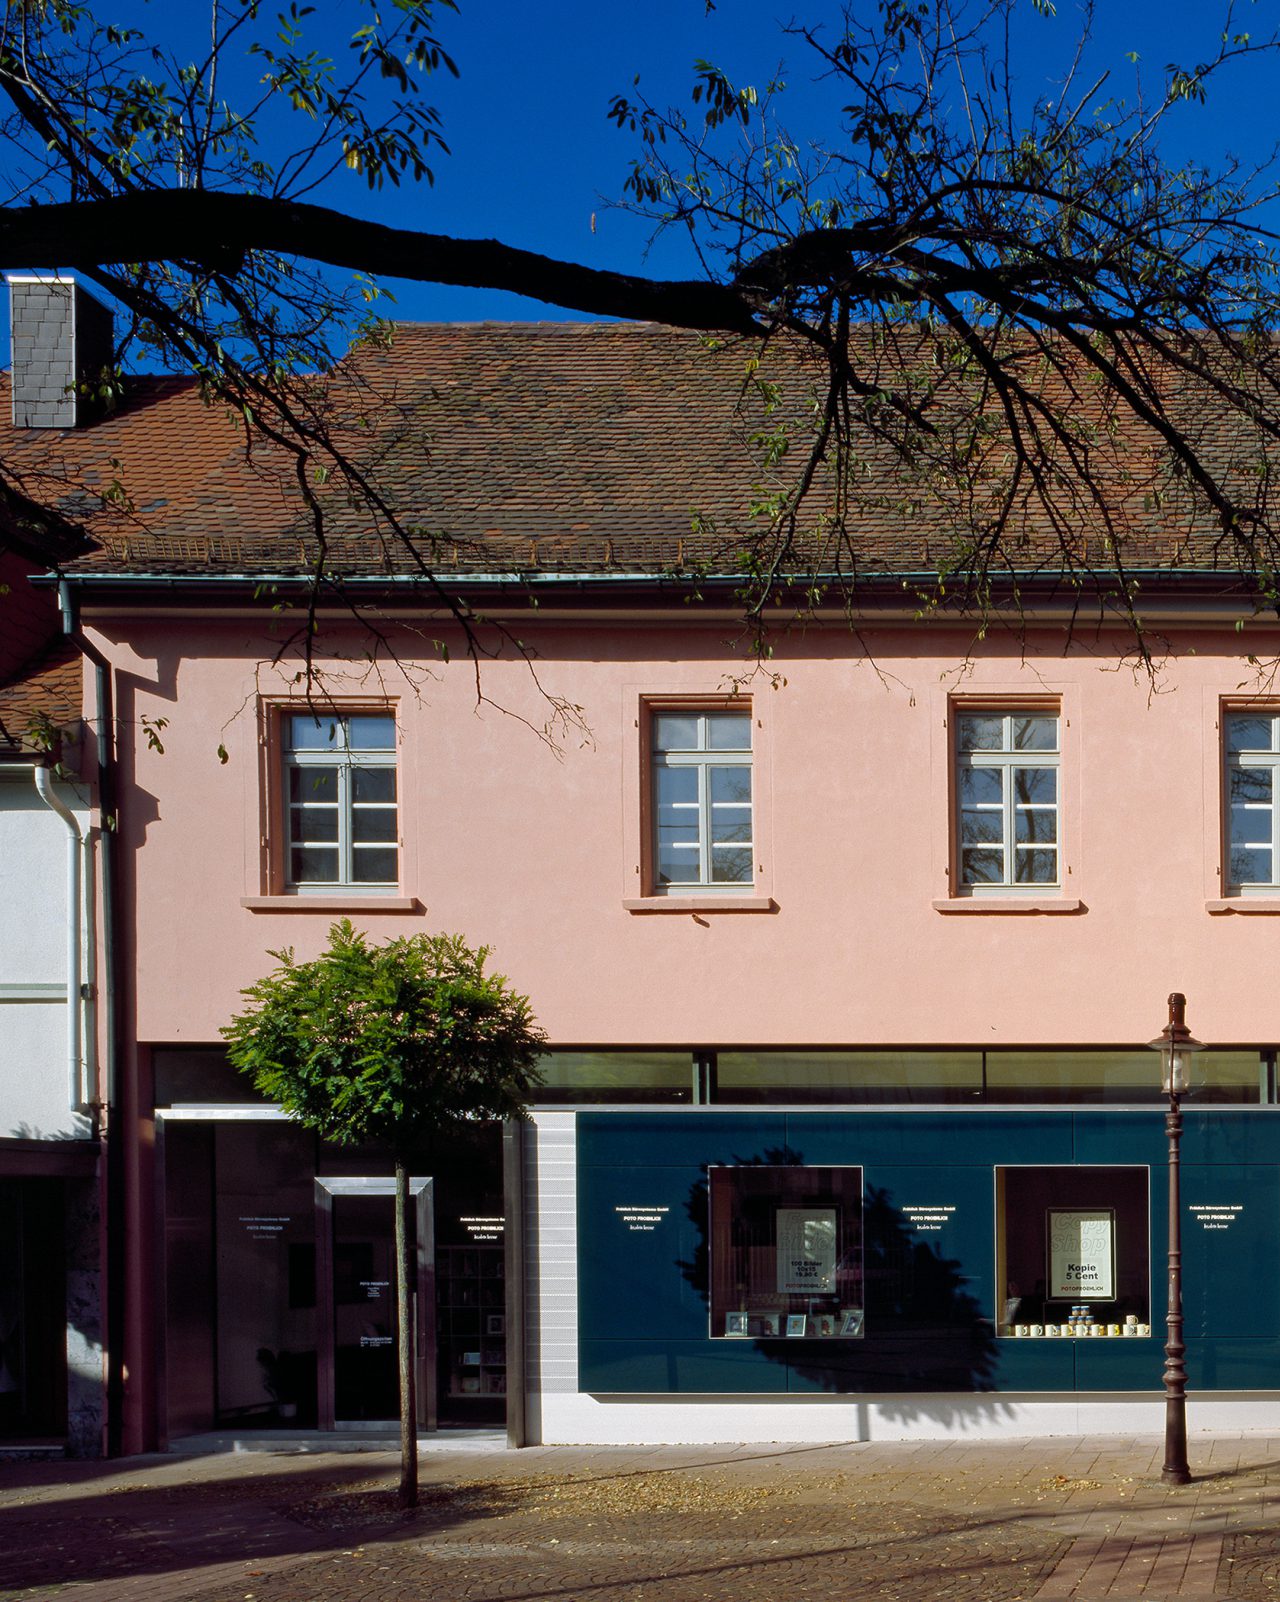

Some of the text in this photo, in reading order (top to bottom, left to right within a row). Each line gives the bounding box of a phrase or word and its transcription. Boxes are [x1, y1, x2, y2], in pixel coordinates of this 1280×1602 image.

[1055, 1214, 1110, 1235] Copy
[1052, 1231, 1106, 1256] Shop
[1068, 1263, 1097, 1272] Kopie
[1066, 1272, 1099, 1280] 5 Cent
